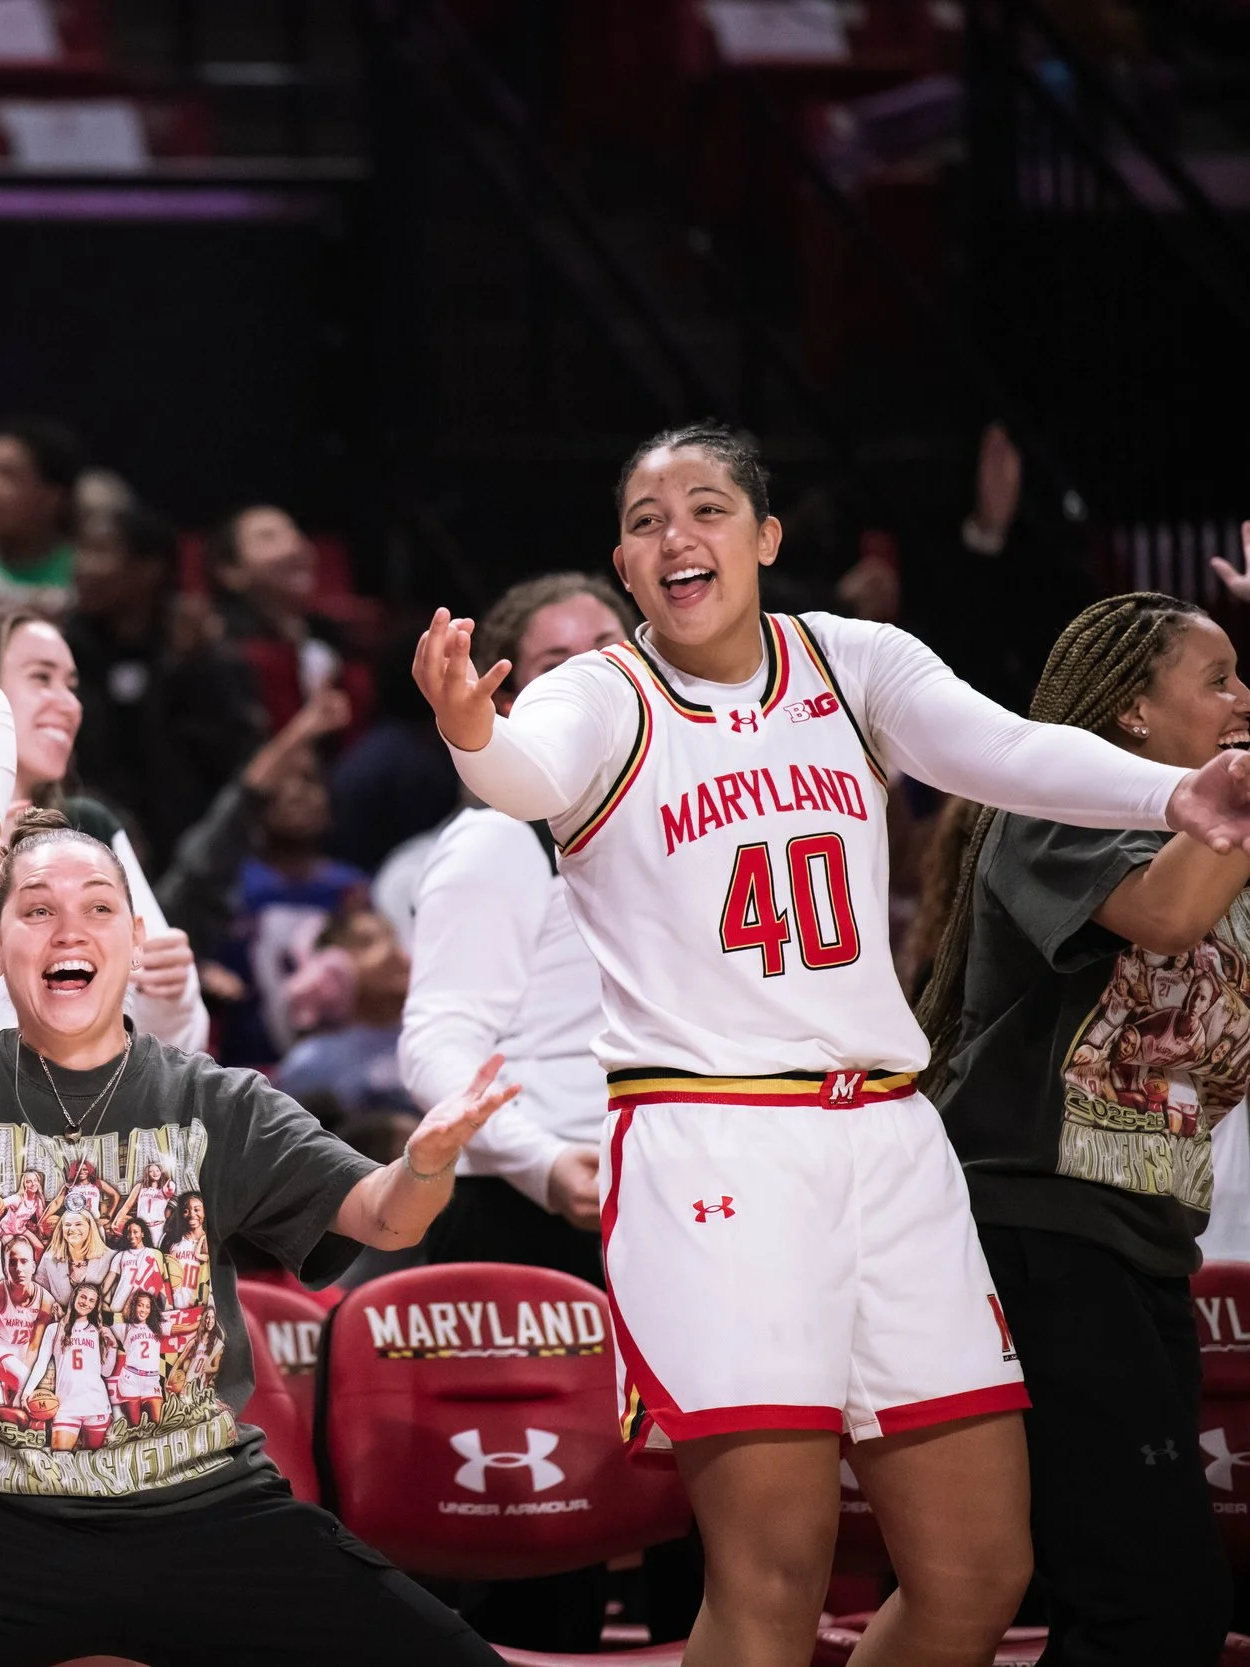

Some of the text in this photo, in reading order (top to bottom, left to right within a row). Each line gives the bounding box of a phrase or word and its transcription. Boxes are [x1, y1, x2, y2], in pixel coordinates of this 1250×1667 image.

[659, 764, 868, 857] MARYLAND
[718, 831, 861, 978] 40
[829, 1073, 861, 1100] M
[182, 1263, 200, 1290] 10
[365, 1301, 605, 1349] MARYLAND
[72, 1349, 83, 1370] 6
[140, 1341, 149, 1359] 2
[438, 1499, 592, 1517] UNDER ARMOUR
